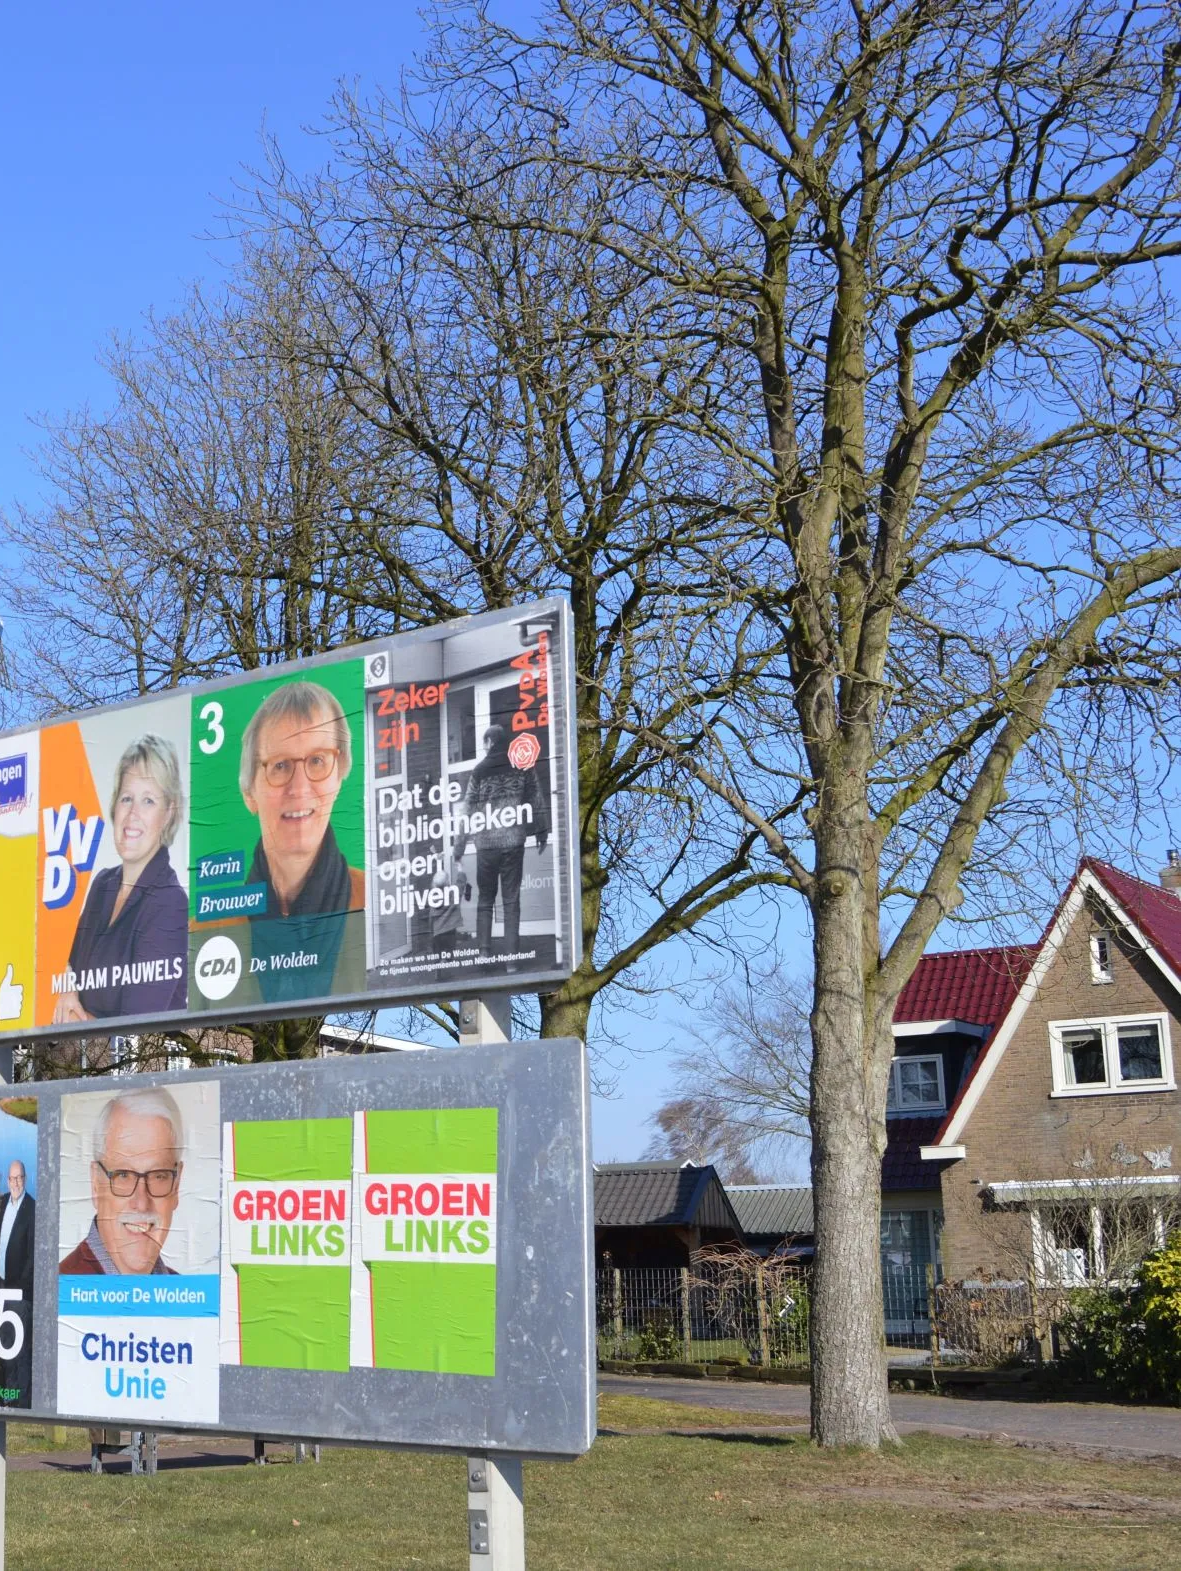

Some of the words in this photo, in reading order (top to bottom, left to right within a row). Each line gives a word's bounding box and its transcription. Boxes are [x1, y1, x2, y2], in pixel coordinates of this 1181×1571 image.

[536, 631, 548, 698] Wolden
[377, 681, 450, 717] Zeker
[537, 702, 549, 727] De
[197, 701, 226, 755] 3
[377, 719, 420, 752] zijn
[379, 783, 424, 815] Dat
[428, 777, 462, 806] de
[379, 802, 533, 848] bibliotheken
[199, 857, 241, 878] Karin
[379, 852, 444, 886] open
[199, 892, 264, 913] Brouwer
[380, 883, 460, 918] blijven
[200, 958, 236, 978] CDA
[249, 957, 267, 973] De
[270, 951, 319, 971] Wolden
[379, 959, 389, 967] Zo
[391, 956, 414, 965] maken
[441, 951, 451, 959] De
[453, 948, 479, 957] Wolden
[390, 966, 409, 976] fijnste
[410, 960, 460, 971] woongemeente
[475, 950, 536, 965] Noord-Nederland!
[51, 967, 107, 994] MIRJAM
[112, 957, 183, 986] PAUWELS
[233, 1188, 346, 1221] GROEN
[364, 1182, 491, 1217] GROEN
[250, 1224, 345, 1257] LINKS
[384, 1219, 490, 1254] LINKS
[71, 1287, 98, 1303] Hart
[101, 1289, 129, 1303] voor
[132, 1287, 151, 1303] De
[154, 1287, 206, 1303] Wolden
[81, 1332, 192, 1364] Christen
[105, 1367, 167, 1400] Unie
